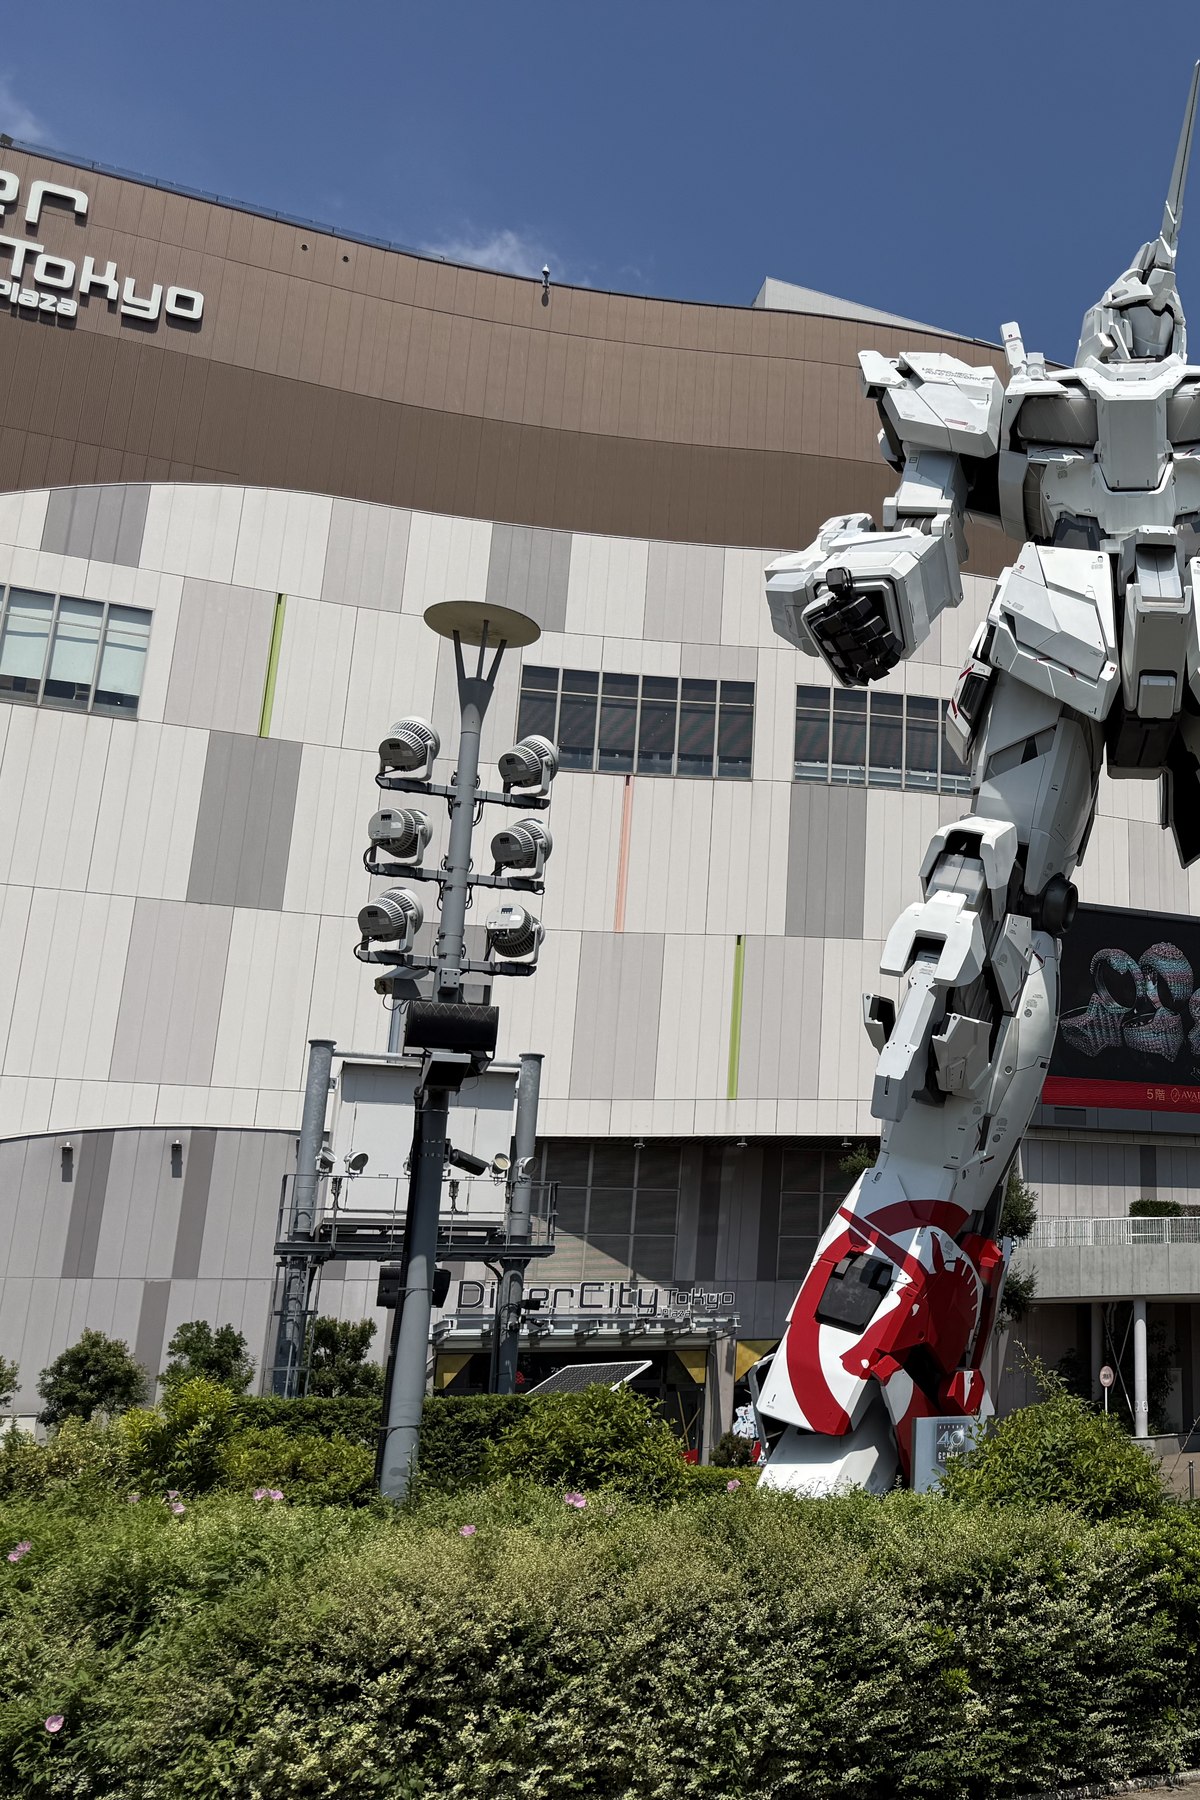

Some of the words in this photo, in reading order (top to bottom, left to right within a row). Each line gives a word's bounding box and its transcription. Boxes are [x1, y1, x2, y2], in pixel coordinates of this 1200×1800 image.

[0, 234, 204, 321] Tokyo
[458, 1279, 658, 1318] DierCity
[663, 1287, 737, 1311] Tokyo
[659, 1308, 692, 1320] Plaza
